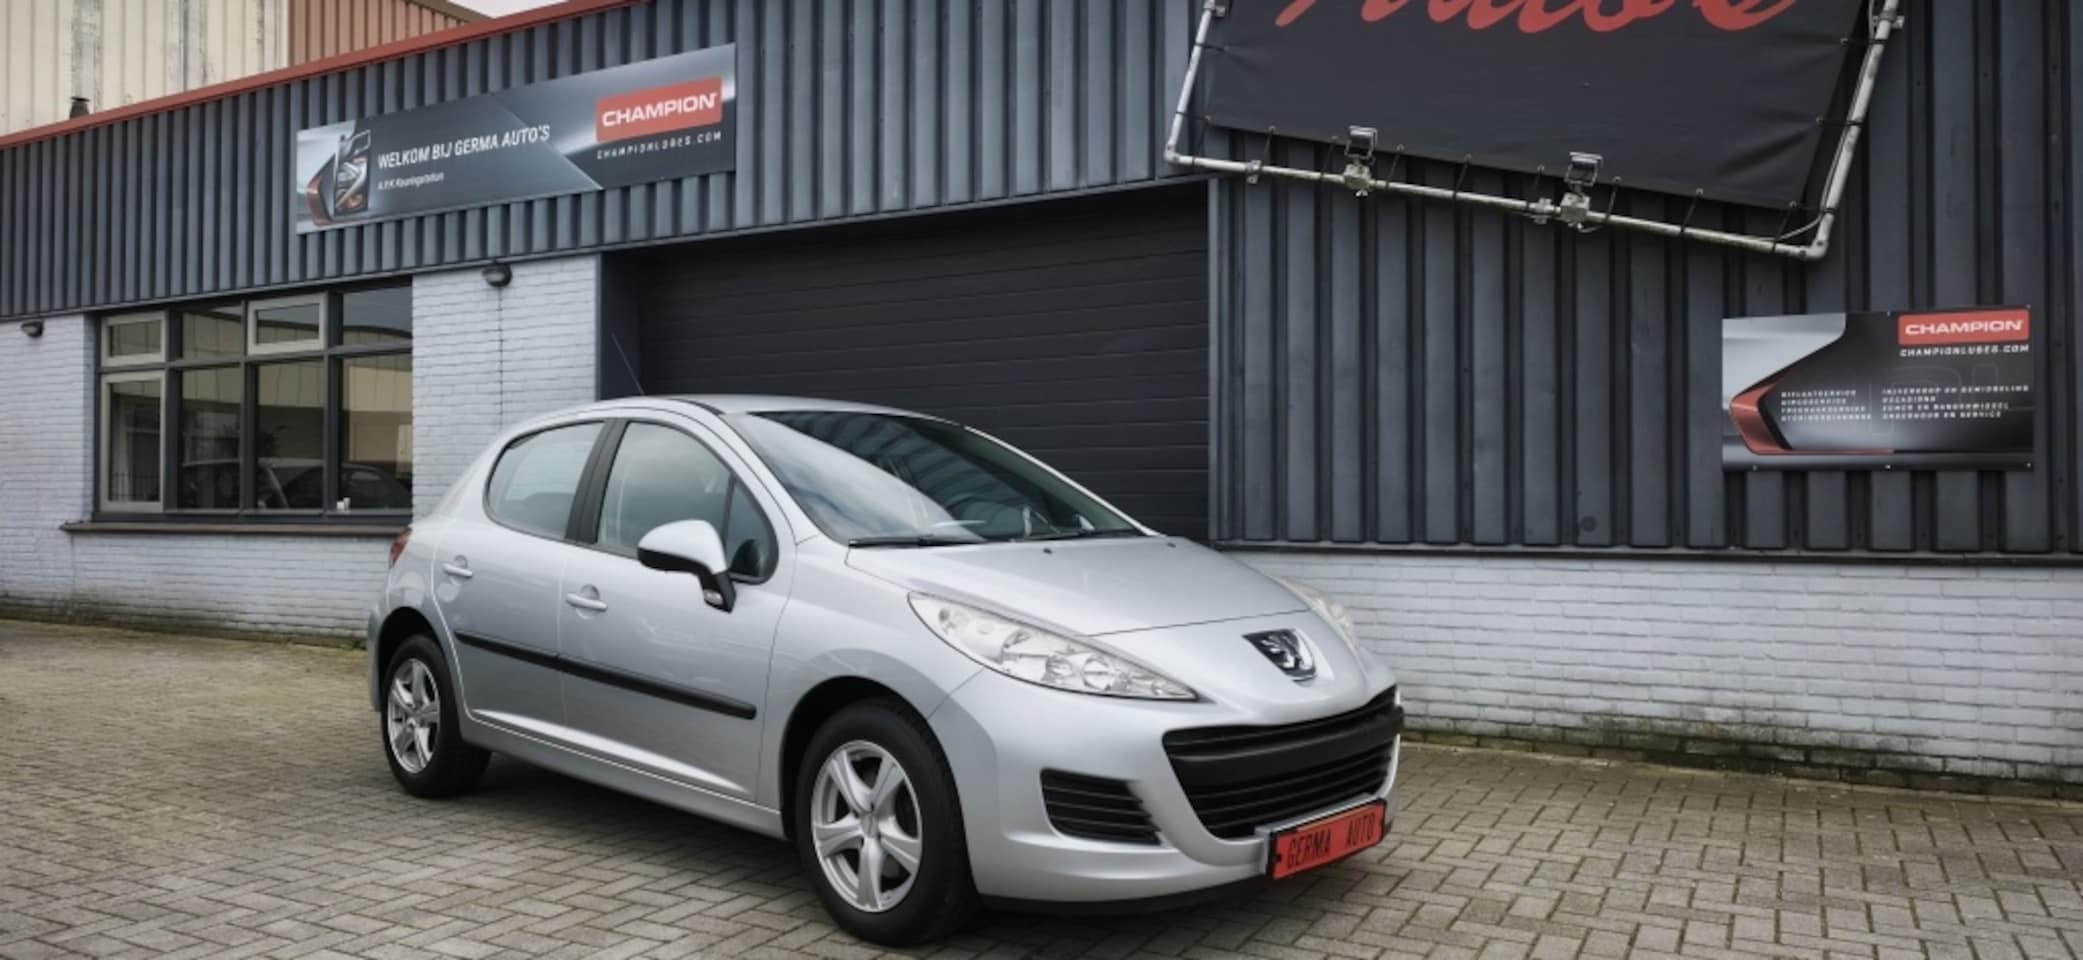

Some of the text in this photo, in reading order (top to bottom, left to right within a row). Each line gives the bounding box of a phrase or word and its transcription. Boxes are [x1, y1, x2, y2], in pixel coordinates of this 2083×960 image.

[602, 92, 717, 127] CHAMPION
[377, 124, 550, 169] WELKOM BIJ GERMA AUTO'S
[1905, 319, 2023, 335] CHAMPION
[1287, 812, 1376, 868] GERMA AUTO
